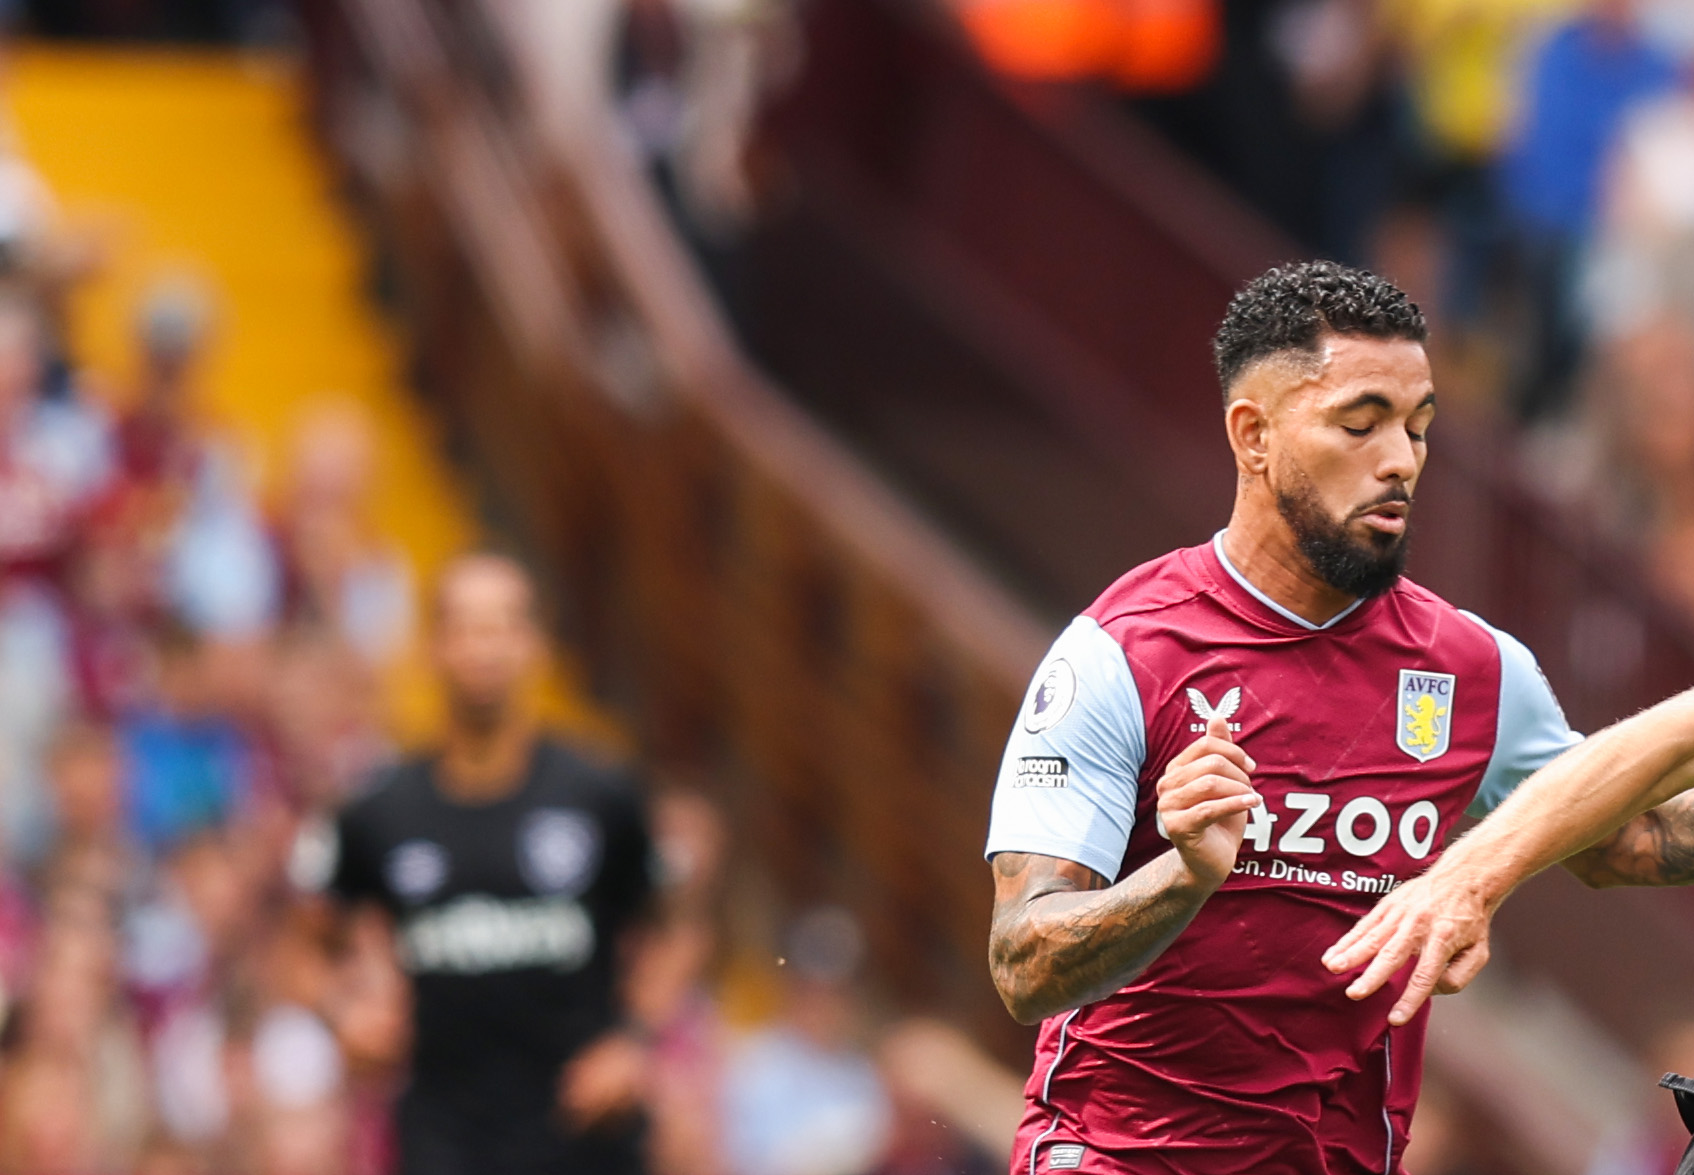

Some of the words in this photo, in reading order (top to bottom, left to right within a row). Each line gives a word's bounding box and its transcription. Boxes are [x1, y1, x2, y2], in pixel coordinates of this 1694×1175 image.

[1404, 677, 1449, 696] AVFC
[1156, 792, 1440, 860] AZOO
[1269, 859, 1338, 887] Drive.
